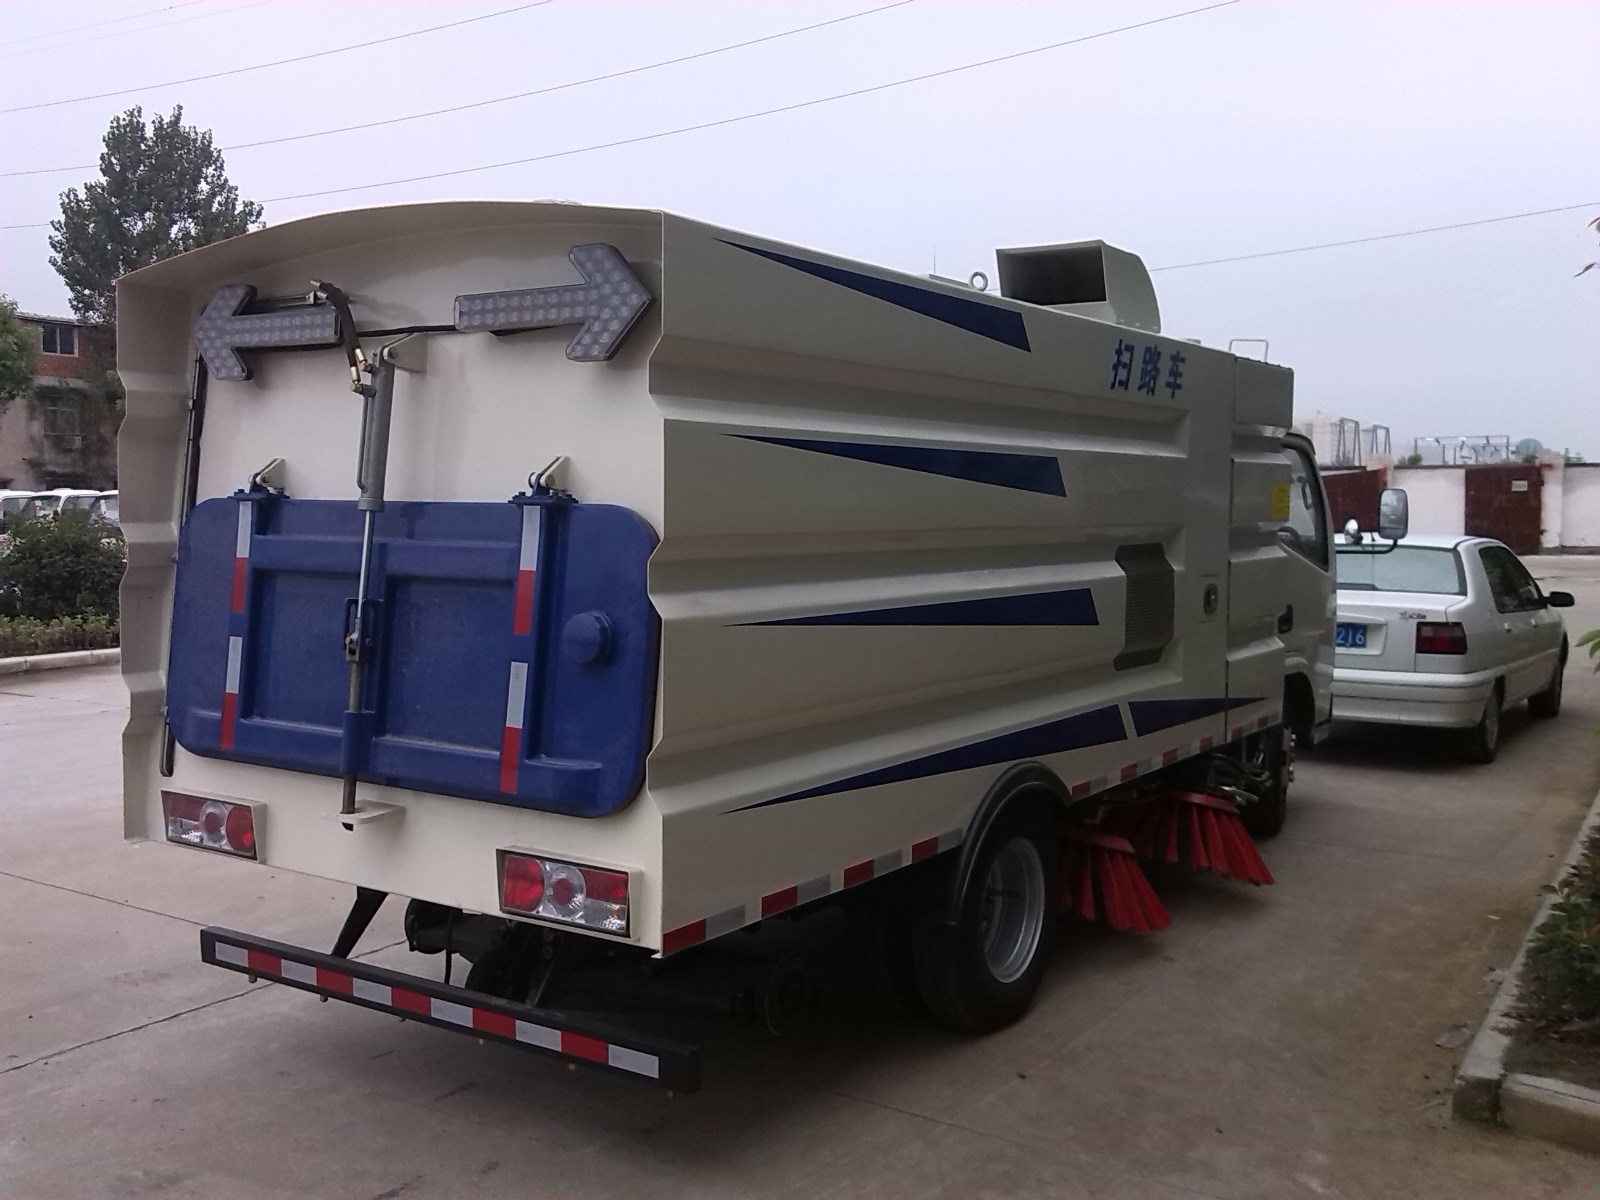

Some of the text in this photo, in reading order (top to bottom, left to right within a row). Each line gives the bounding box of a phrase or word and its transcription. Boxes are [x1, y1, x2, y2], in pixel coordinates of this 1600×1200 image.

[1110, 338, 1186, 399] 扫路车
[1336, 627, 1365, 645] 216
